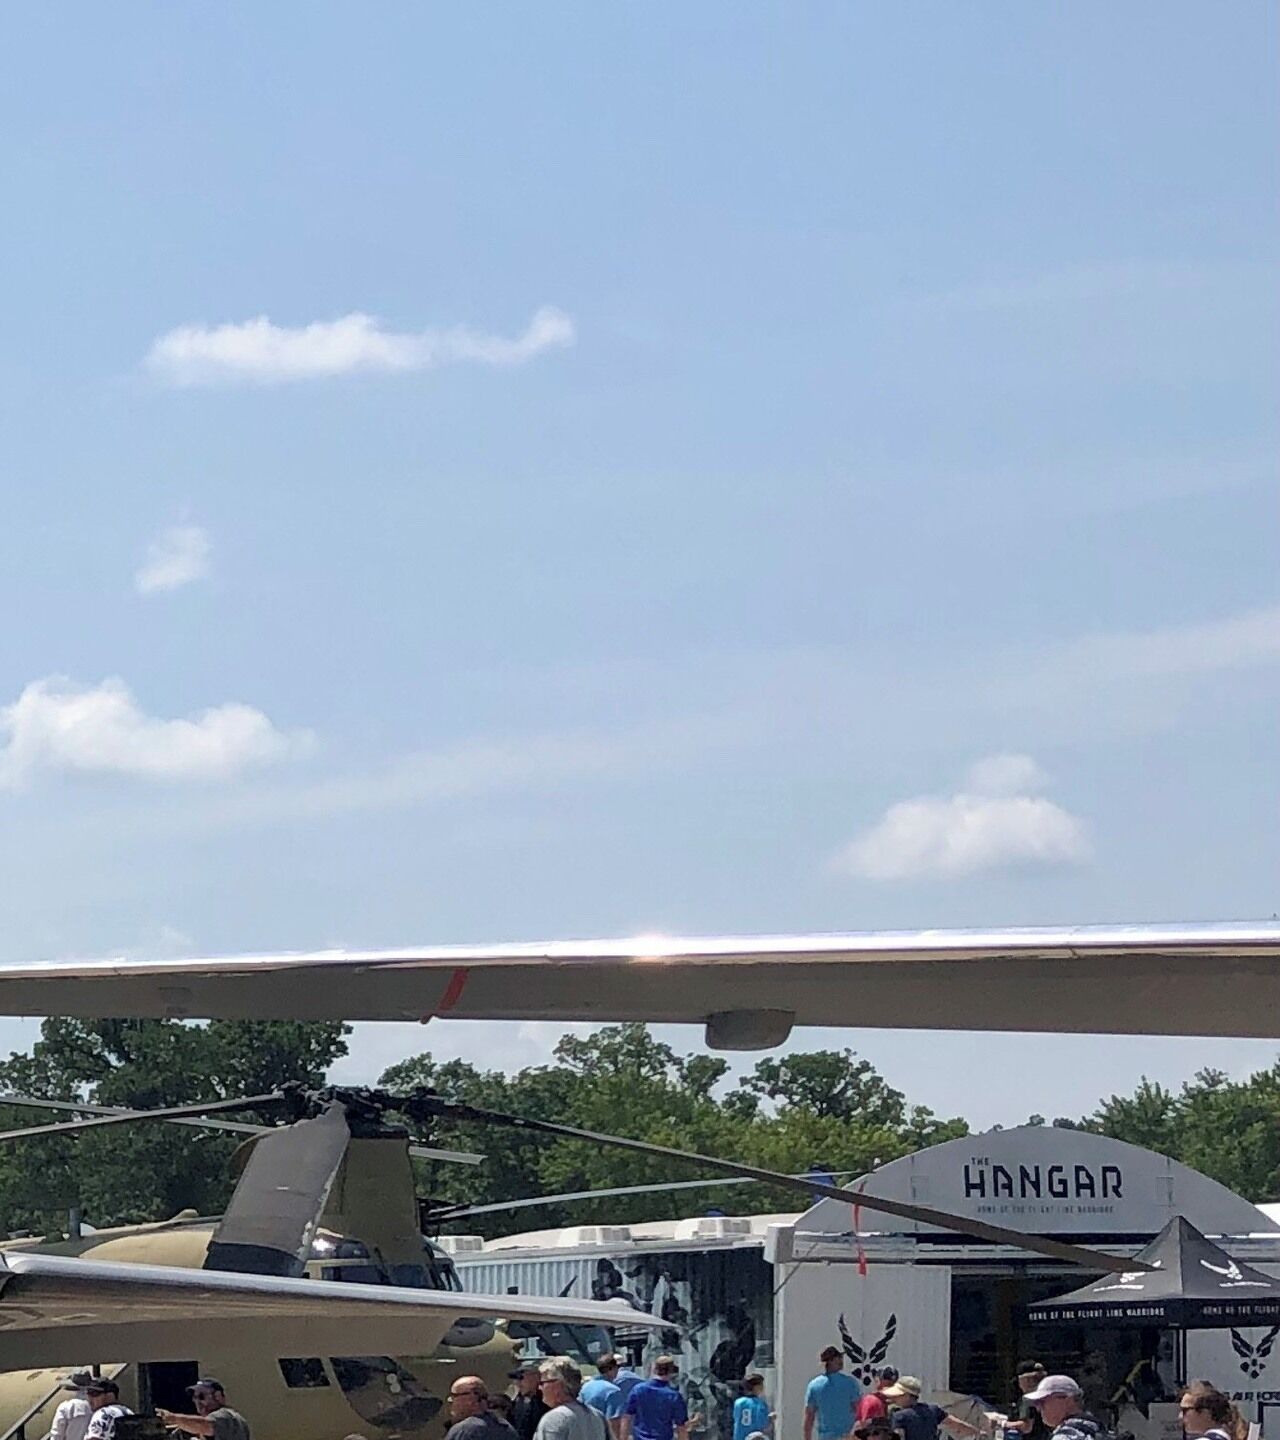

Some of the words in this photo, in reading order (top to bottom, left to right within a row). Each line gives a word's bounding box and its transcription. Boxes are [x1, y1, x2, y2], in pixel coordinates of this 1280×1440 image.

[971, 1157, 990, 1166] THE
[963, 1164, 1123, 1199] HANGAR
[742, 1408, 752, 1426] 8
